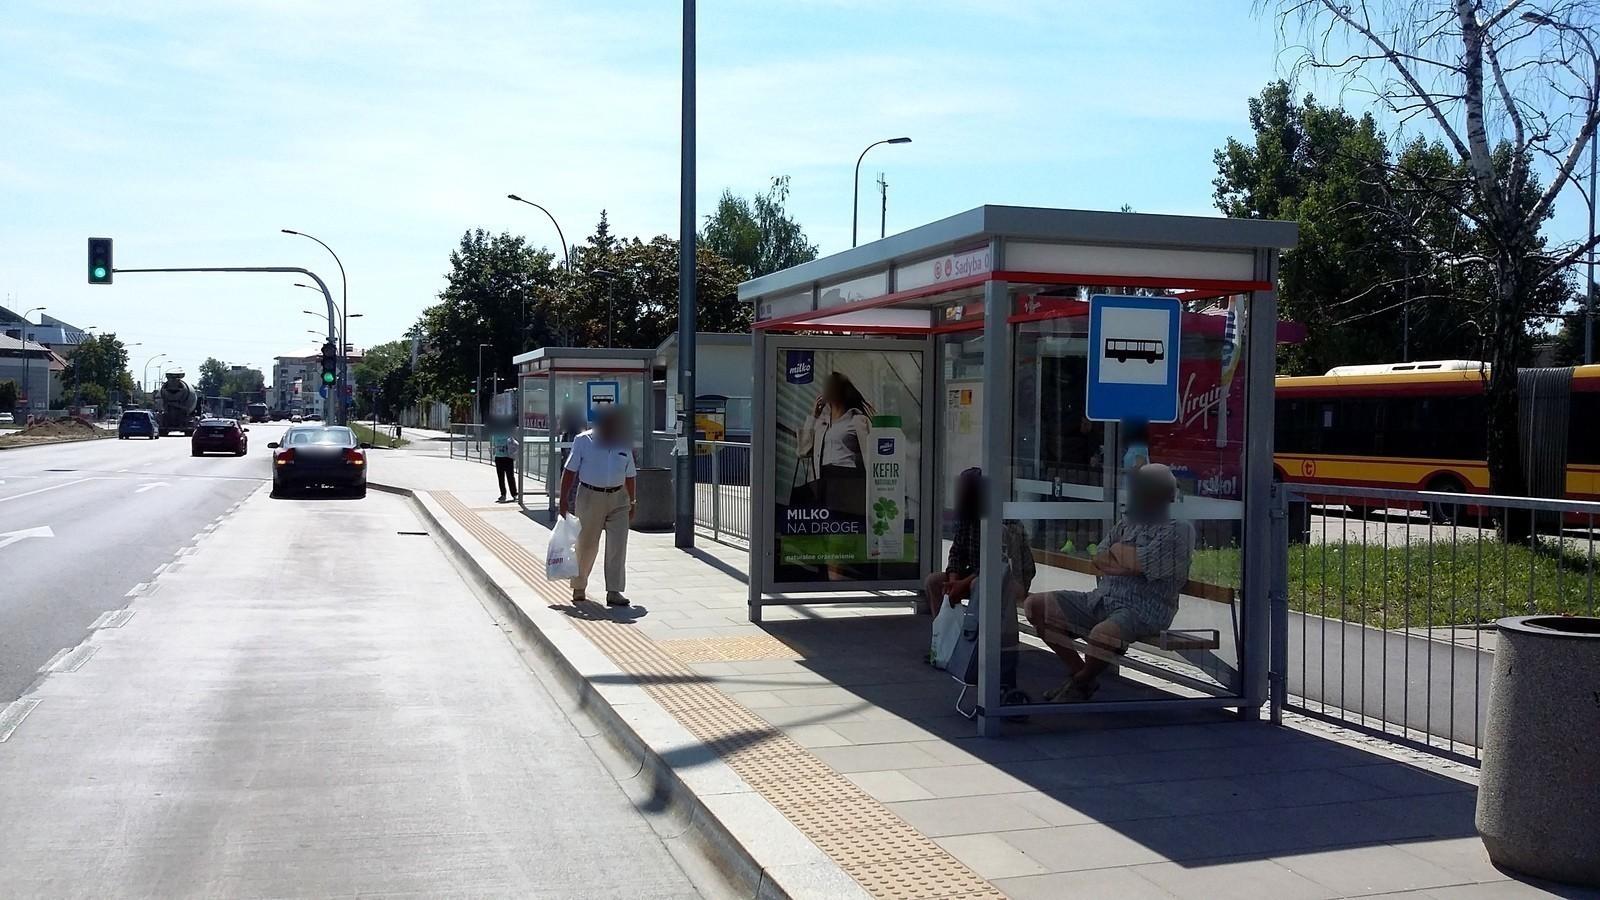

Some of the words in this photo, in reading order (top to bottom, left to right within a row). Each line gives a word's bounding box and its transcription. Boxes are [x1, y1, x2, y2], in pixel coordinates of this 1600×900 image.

[955, 256, 982, 276] Sadyba
[790, 362, 811, 374] milko
[1178, 372, 1230, 430] Virgin
[872, 462, 900, 478] KEFIR
[787, 509, 829, 520] MILKO
[787, 522, 807, 534] NA
[811, 521, 859, 534] DROGĘ
